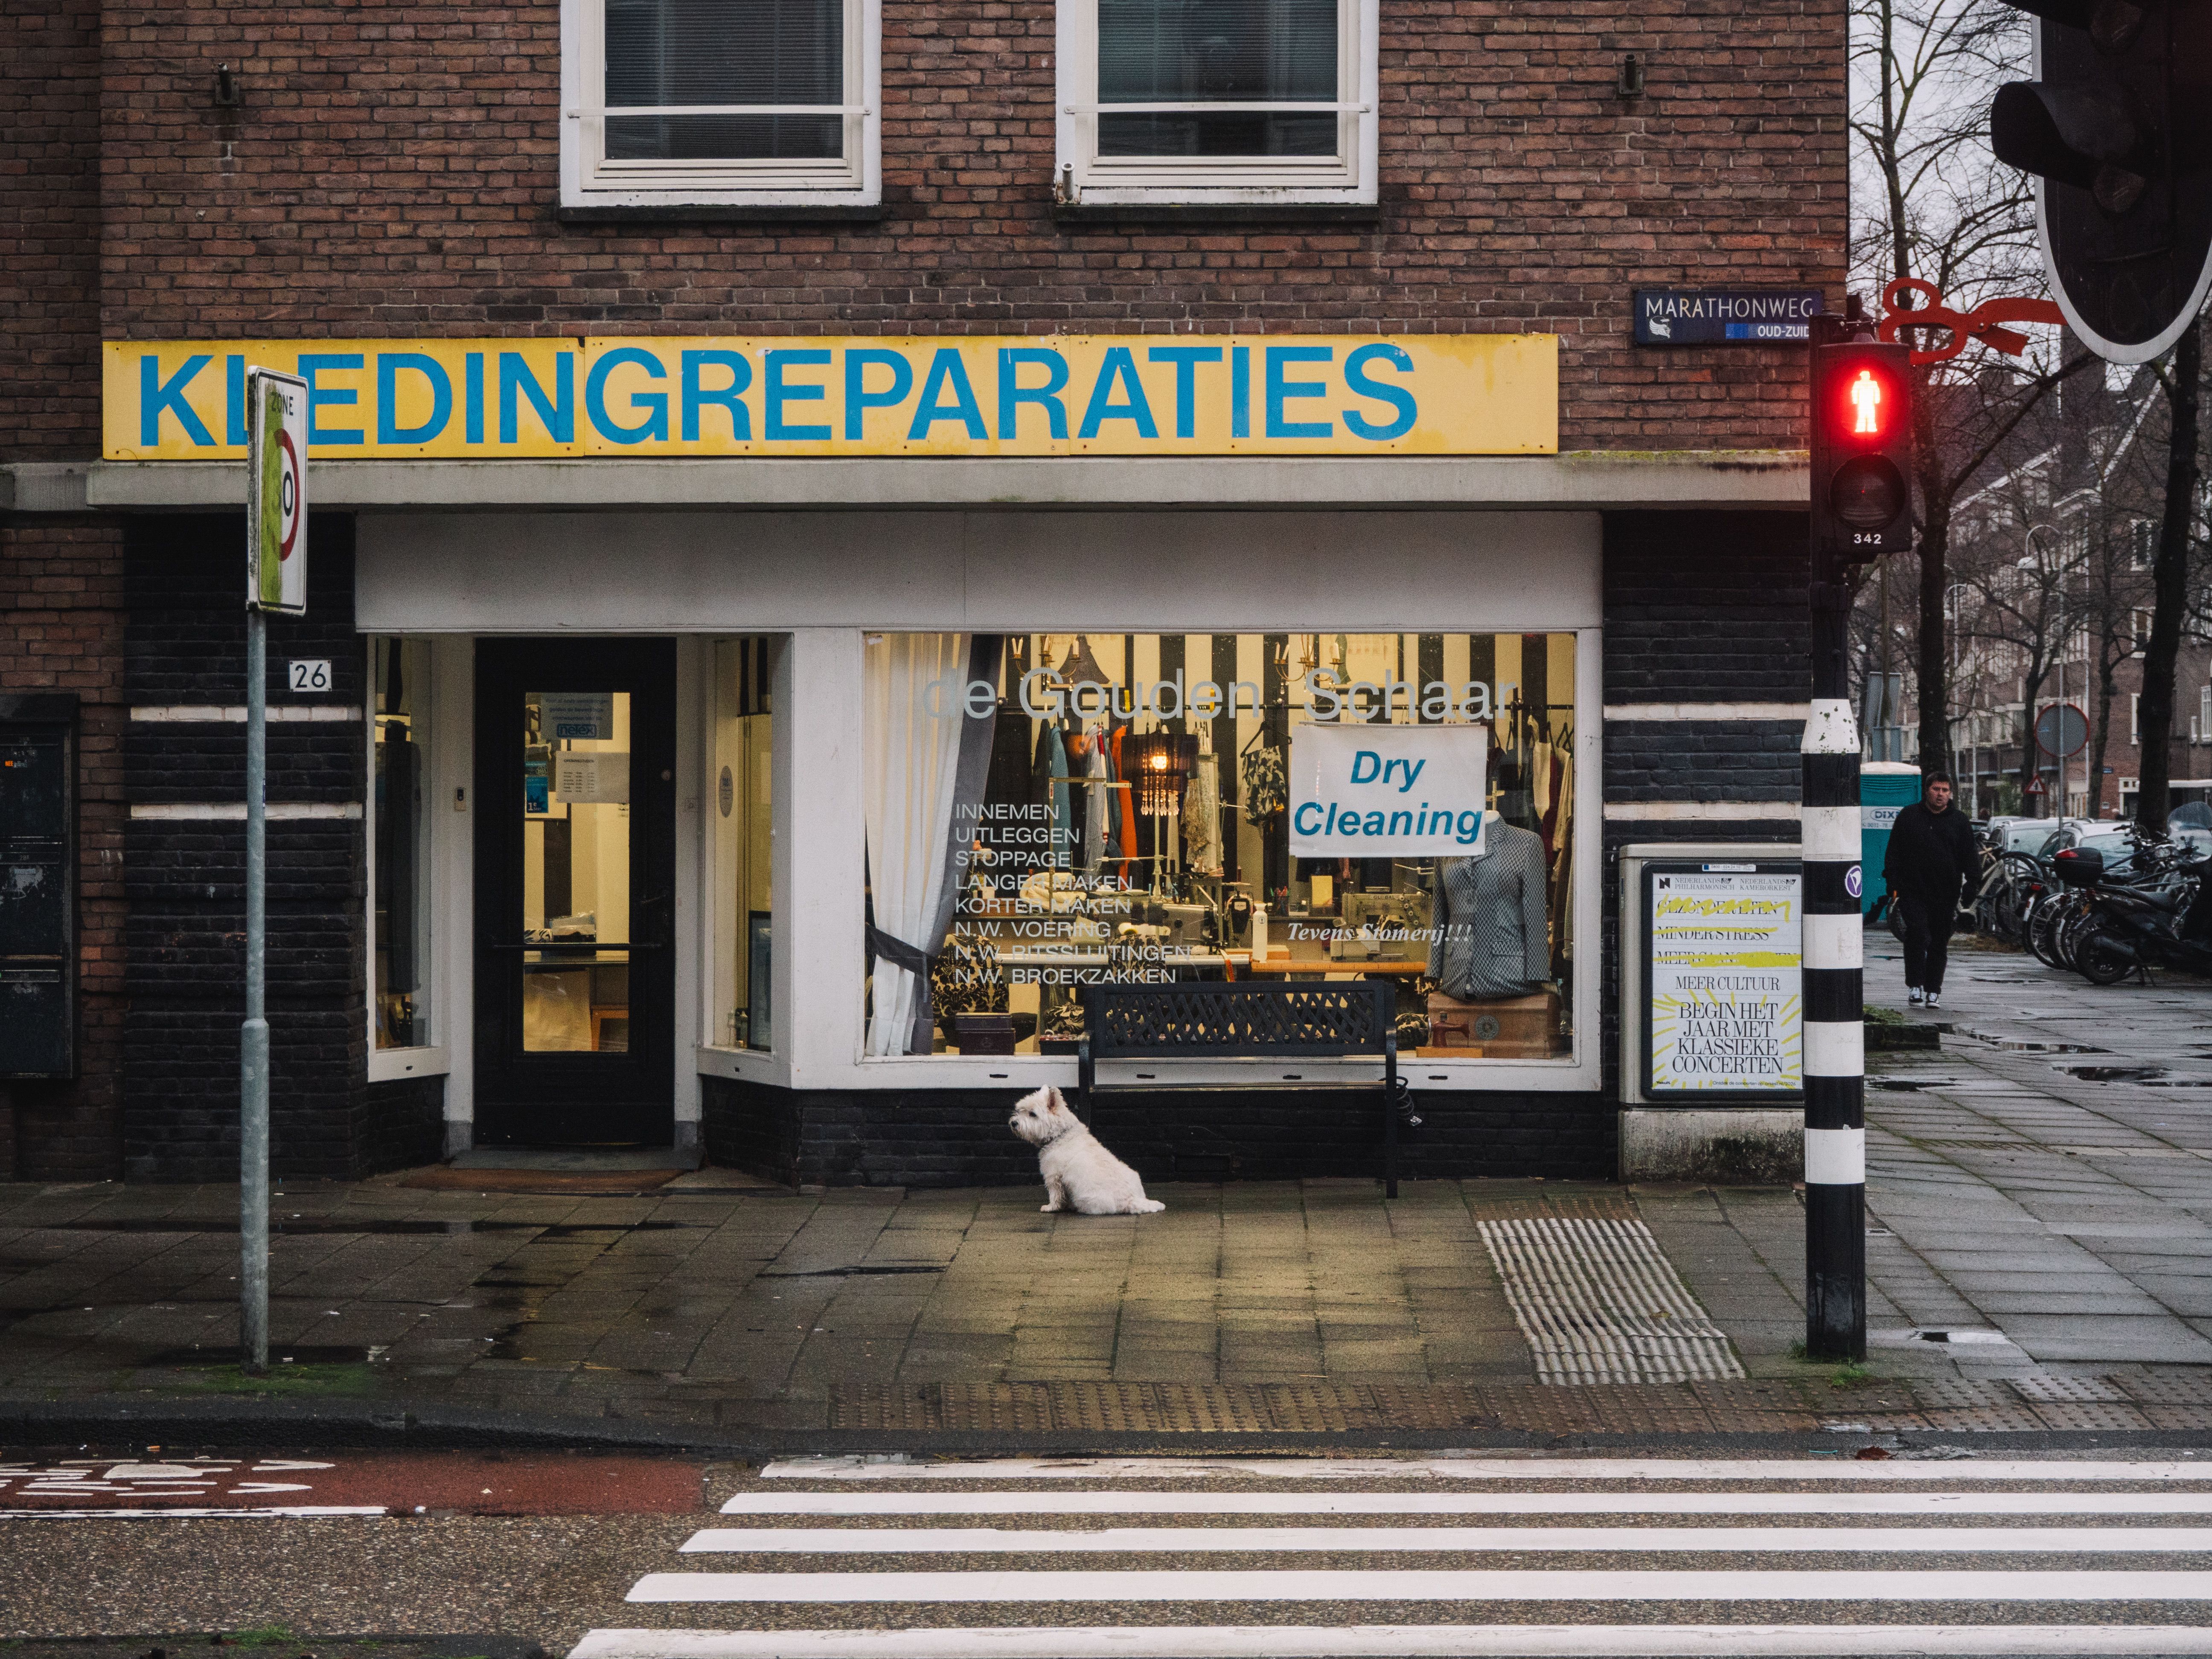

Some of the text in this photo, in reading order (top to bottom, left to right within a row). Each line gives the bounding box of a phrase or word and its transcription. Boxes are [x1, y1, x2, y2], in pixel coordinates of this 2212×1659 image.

[1645, 297, 1813, 318] MARATHONWEG
[1757, 326, 1810, 338] OUD-ZUID
[140, 343, 1417, 446] KLEDINGREPARATIES
[271, 392, 294, 416] ZONE
[1854, 533, 1882, 544] 342
[294, 664, 326, 689] 26
[923, 667, 1518, 720] de Gouden Schaar
[1350, 751, 1426, 792] Dry
[956, 804, 1059, 819] INNEMEN
[1294, 802, 1483, 844] Cleaning
[955, 828, 1079, 843] UITLEGGEN
[955, 851, 1071, 867] STOPPAGE
[955, 874, 1133, 891] LANGER MAKEN
[955, 898, 1131, 914] KORTER MAKEN
[955, 921, 1111, 937] N.W. VOERING
[1287, 923, 1472, 947] Tevens Stomerij!!!
[1657, 926, 1769, 941] MINDER STRESS
[1012, 945, 1191, 961] RITSSLUITINGEN
[1012, 968, 1176, 984] BROEKZAKKEN
[1675, 976, 1781, 990] MEER CULTUUR
[1679, 1002, 1778, 1020] BEGIN HET
[1683, 1020, 1774, 1038] JAAR MET
[1677, 1038, 1778, 1056] KLASSIEKE
[1672, 1056, 1784, 1074] CONCERTEN
